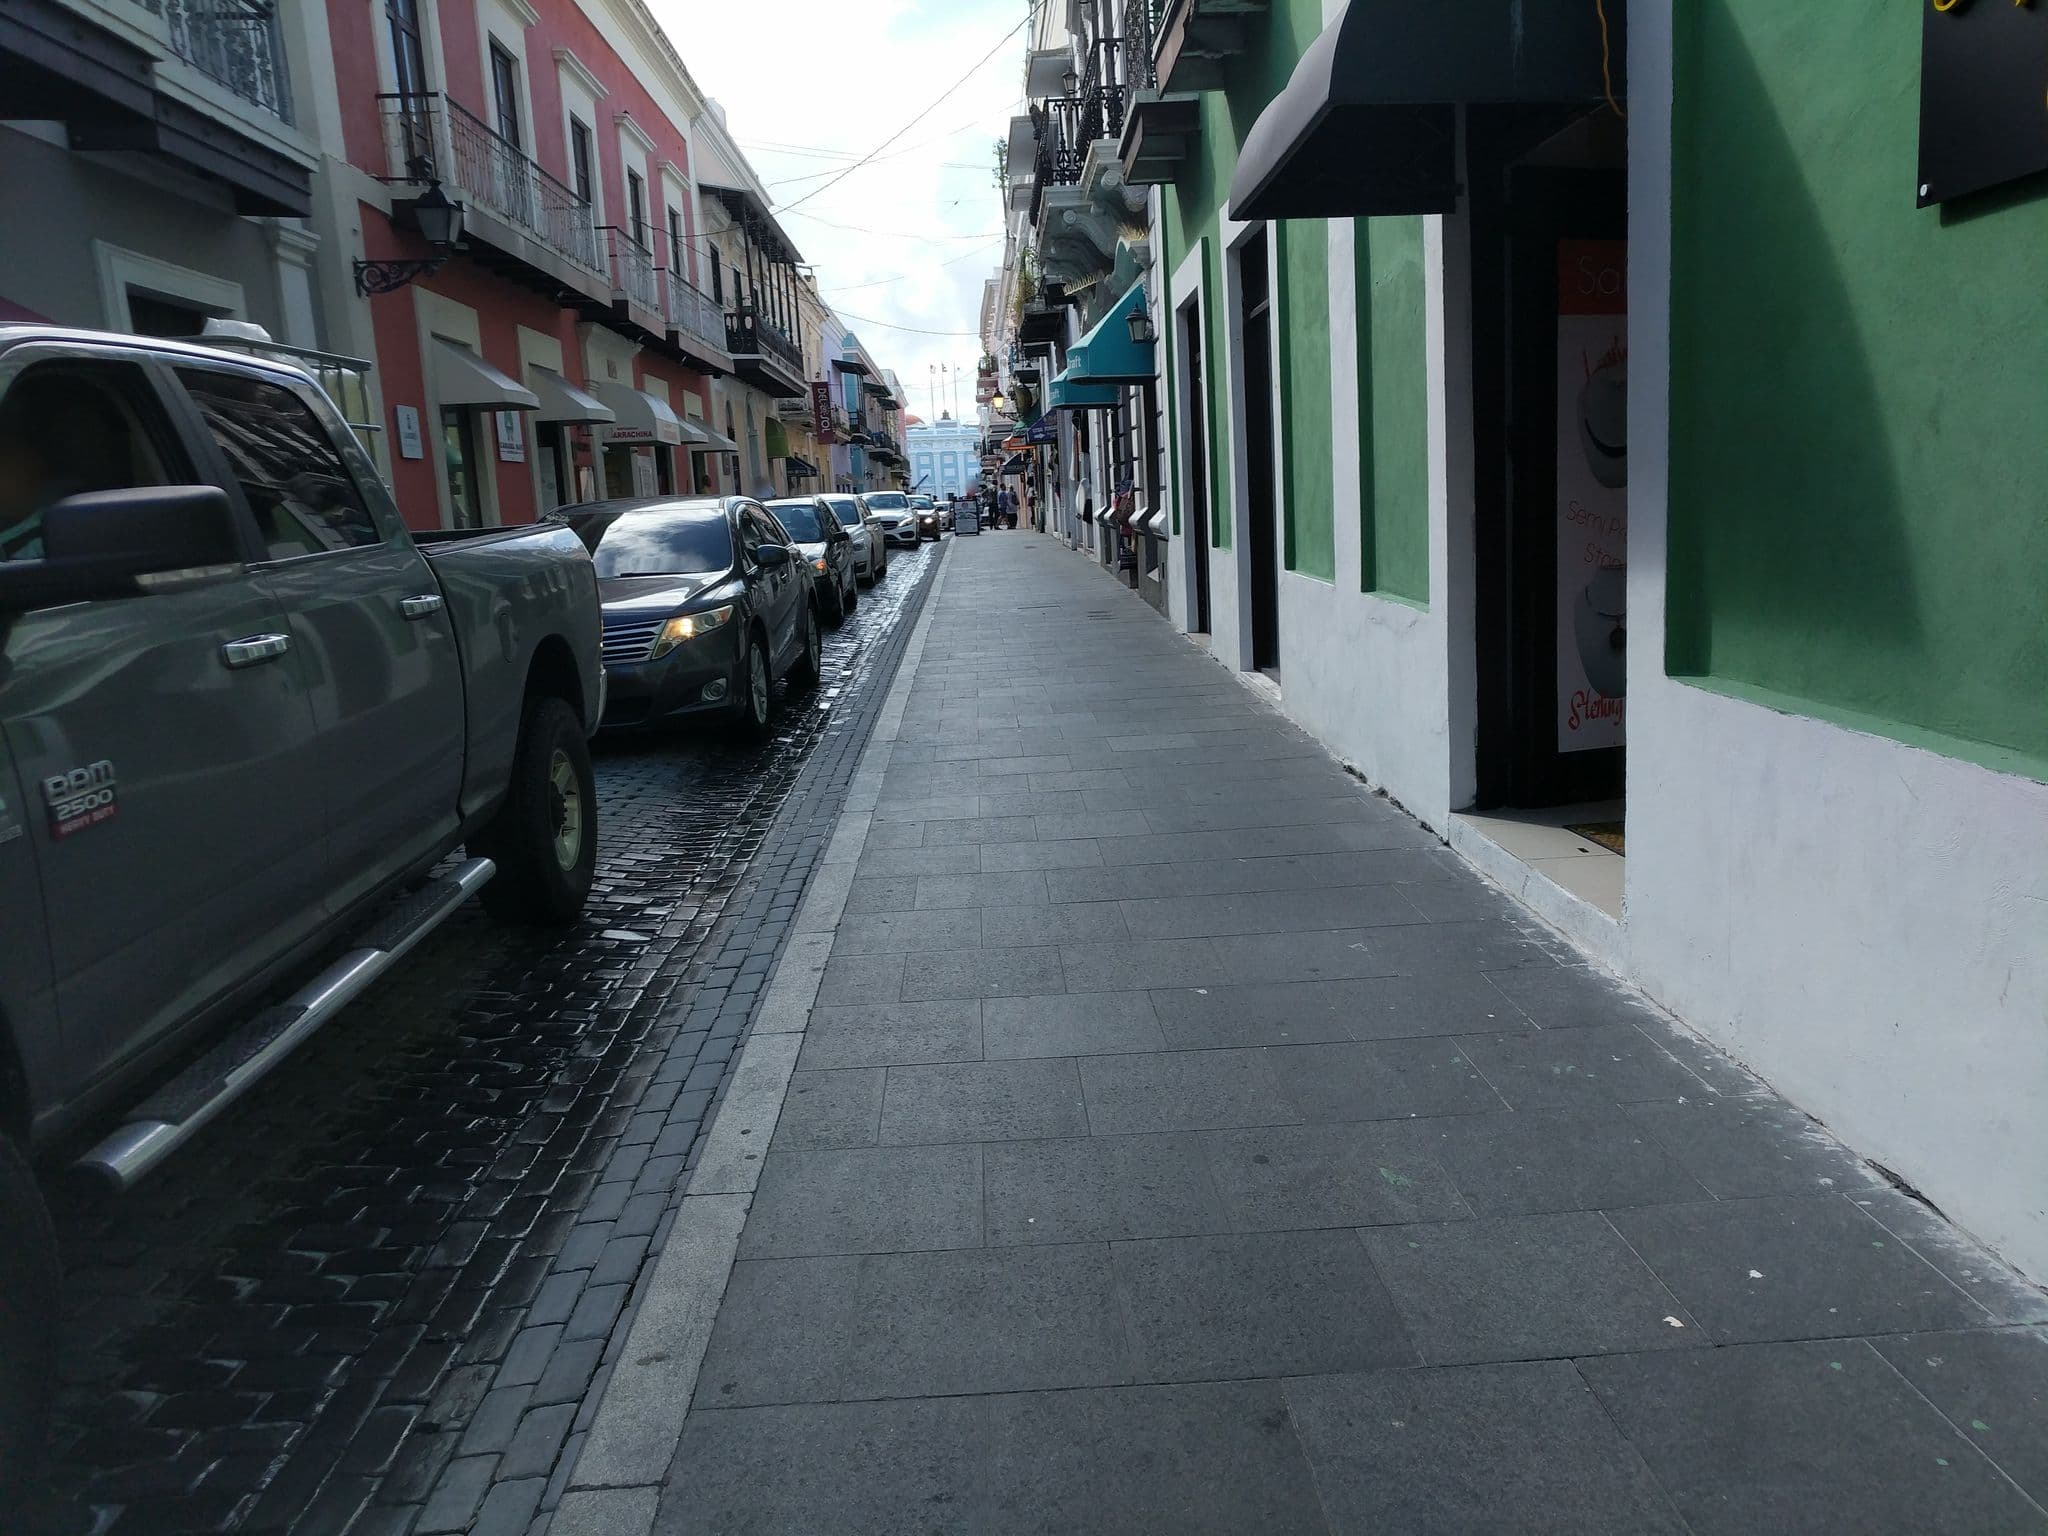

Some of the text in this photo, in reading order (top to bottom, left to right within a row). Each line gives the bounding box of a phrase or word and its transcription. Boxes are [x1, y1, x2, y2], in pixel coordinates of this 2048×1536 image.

[1576, 255, 1627, 296] Sa
[817, 387, 831, 434] DEL SOL
[43, 759, 115, 803] RAM
[56, 789, 114, 821] 2500
